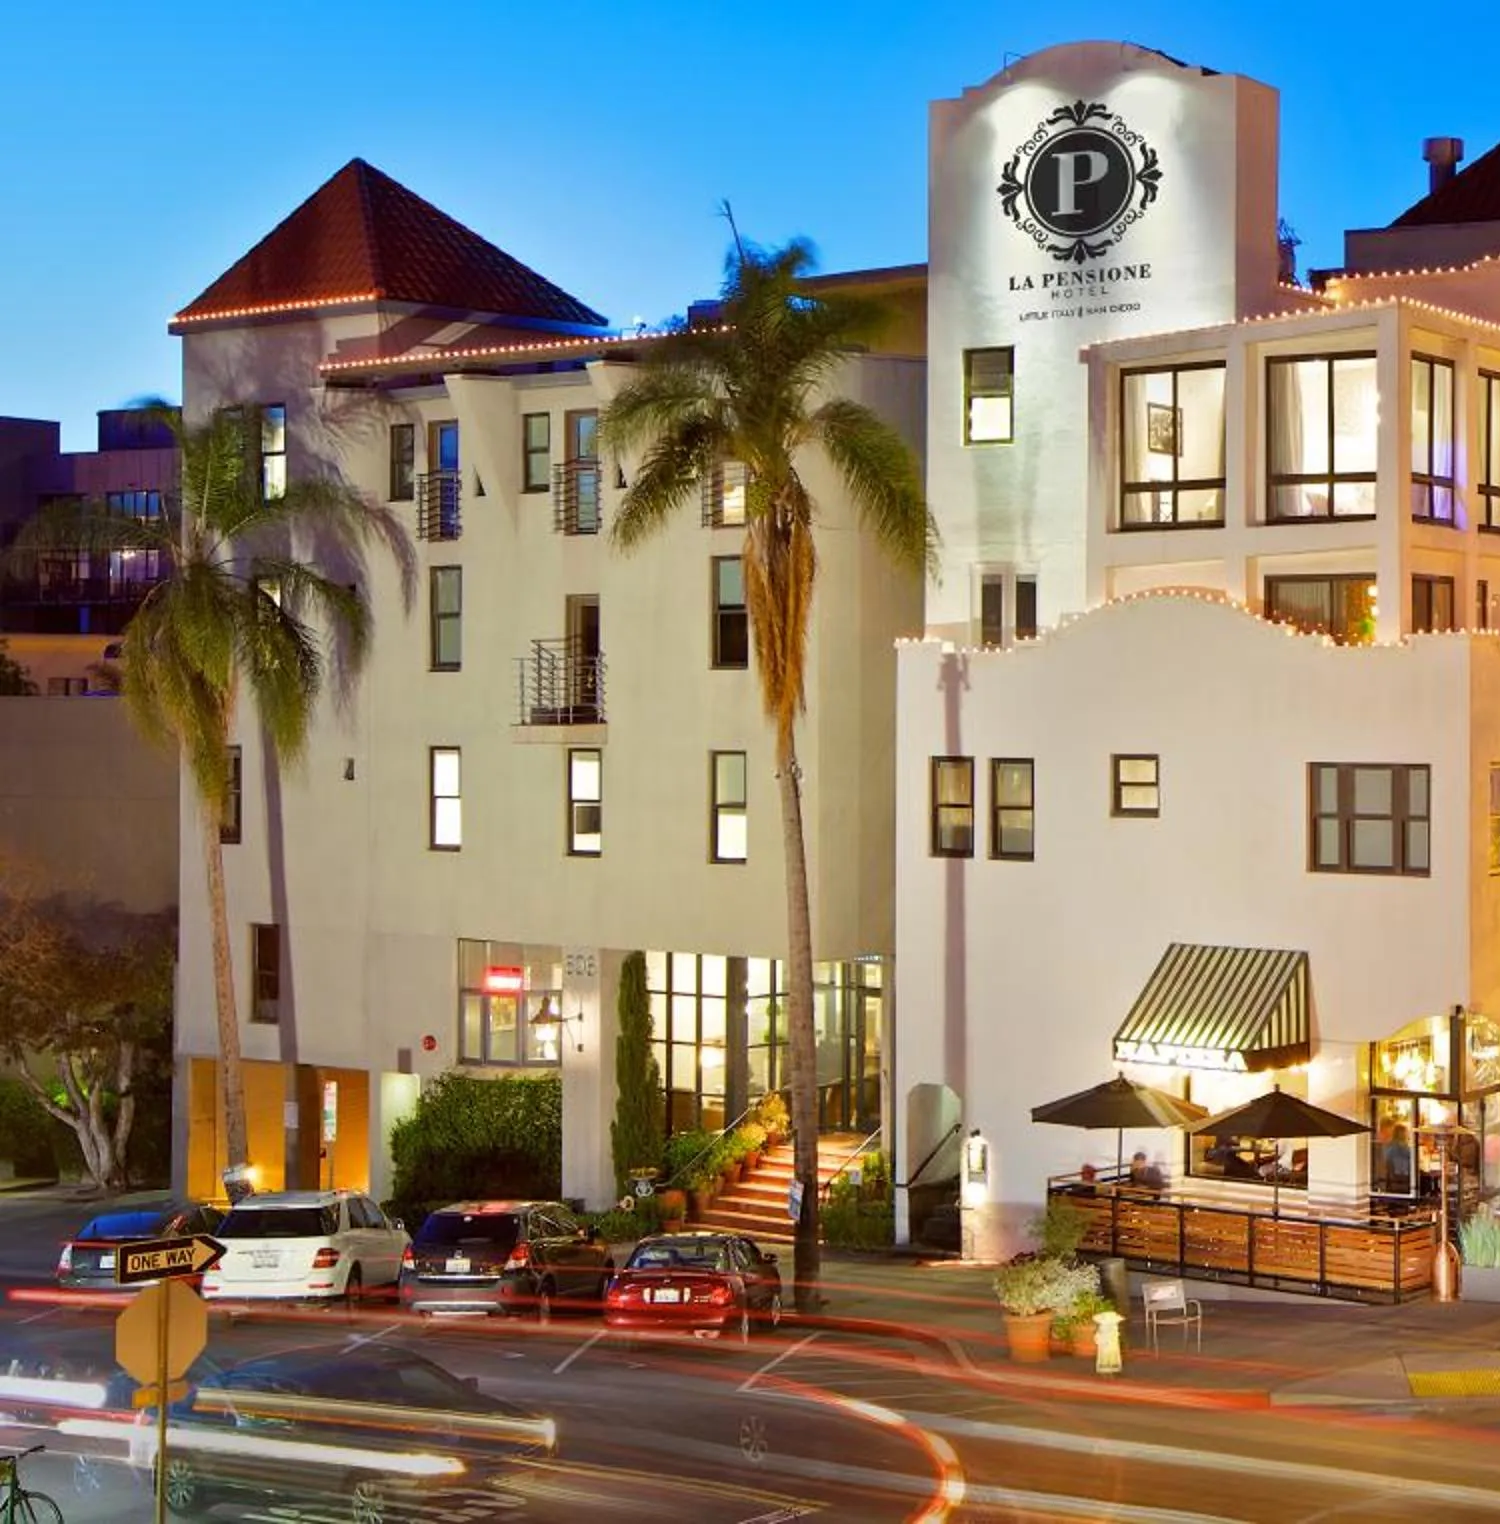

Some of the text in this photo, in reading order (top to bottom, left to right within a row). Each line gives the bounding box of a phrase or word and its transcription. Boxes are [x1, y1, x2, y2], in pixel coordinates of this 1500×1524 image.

[1051, 150, 1109, 216] P
[1009, 263, 1151, 291] LA PENSIONE
[1051, 286, 1109, 300] HOTEL
[131, 1247, 197, 1271] ONE WAY
